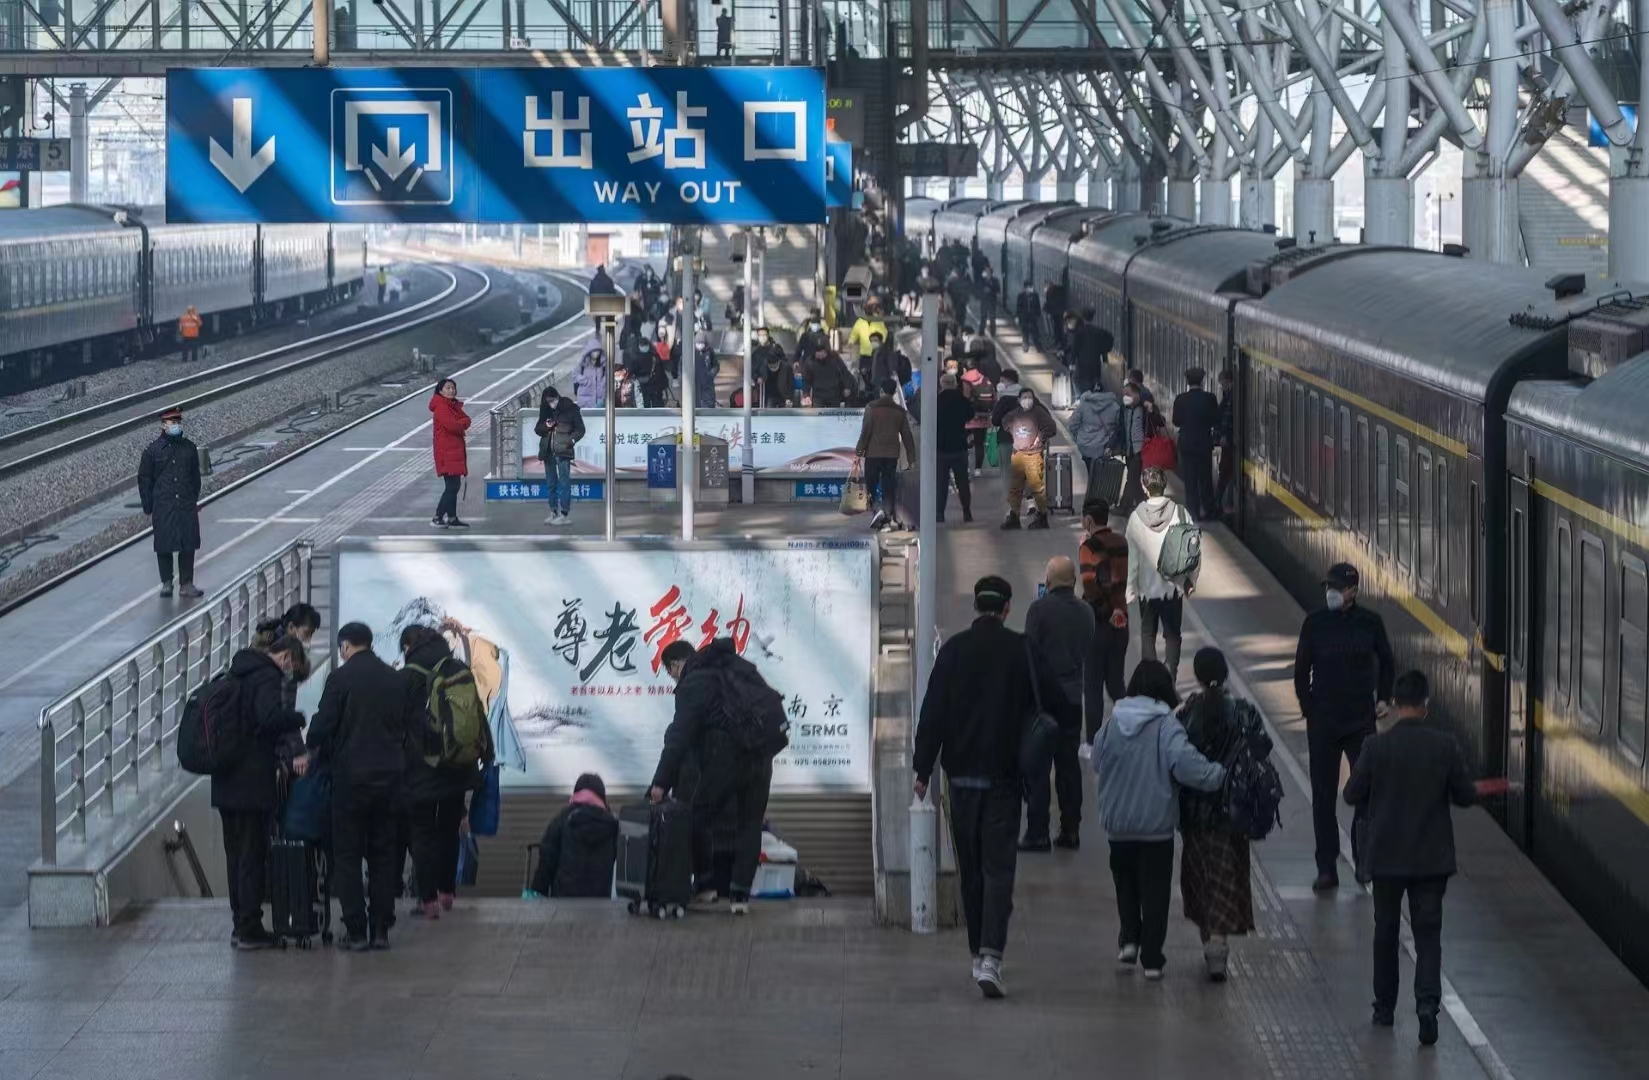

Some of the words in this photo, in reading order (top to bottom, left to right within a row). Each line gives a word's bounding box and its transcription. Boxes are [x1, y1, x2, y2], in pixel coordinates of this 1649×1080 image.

[523, 90, 807, 169] 出站口
[48, 141, 61, 159] 5
[593, 180, 661, 203] WAY
[679, 180, 741, 203] OUT
[787, 692, 843, 718] 南京
[801, 723, 848, 738] SRMG
